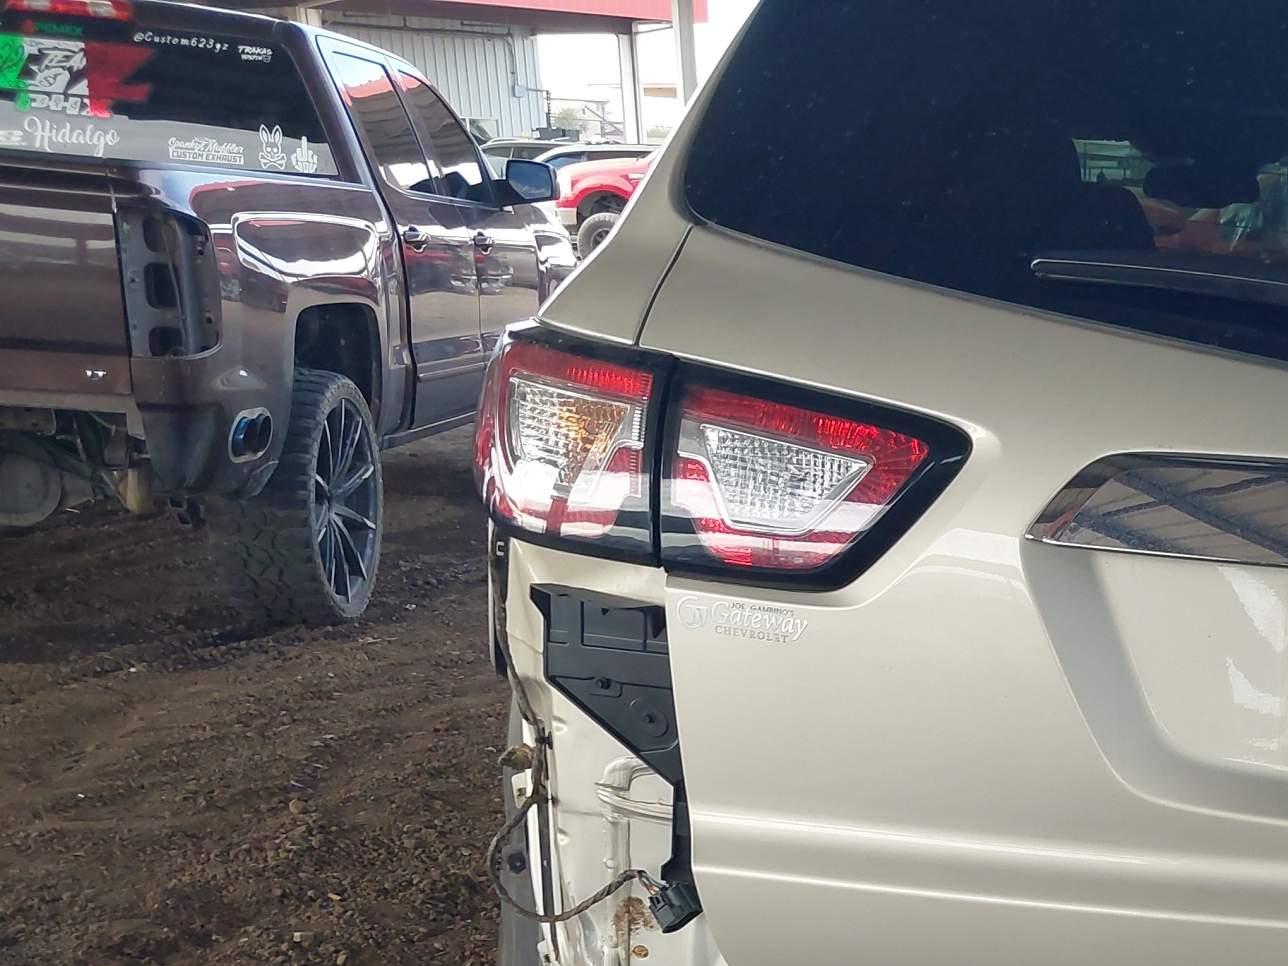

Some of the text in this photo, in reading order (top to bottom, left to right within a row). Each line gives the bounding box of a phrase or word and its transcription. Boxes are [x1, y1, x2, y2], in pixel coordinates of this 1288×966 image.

[24, 115, 121, 157] Hidalgo
[205, 153, 243, 163] EXHAUST
[731, 602, 746, 610] JOE
[711, 600, 808, 641] Gateway
[715, 625, 789, 643] CHEVROLET
